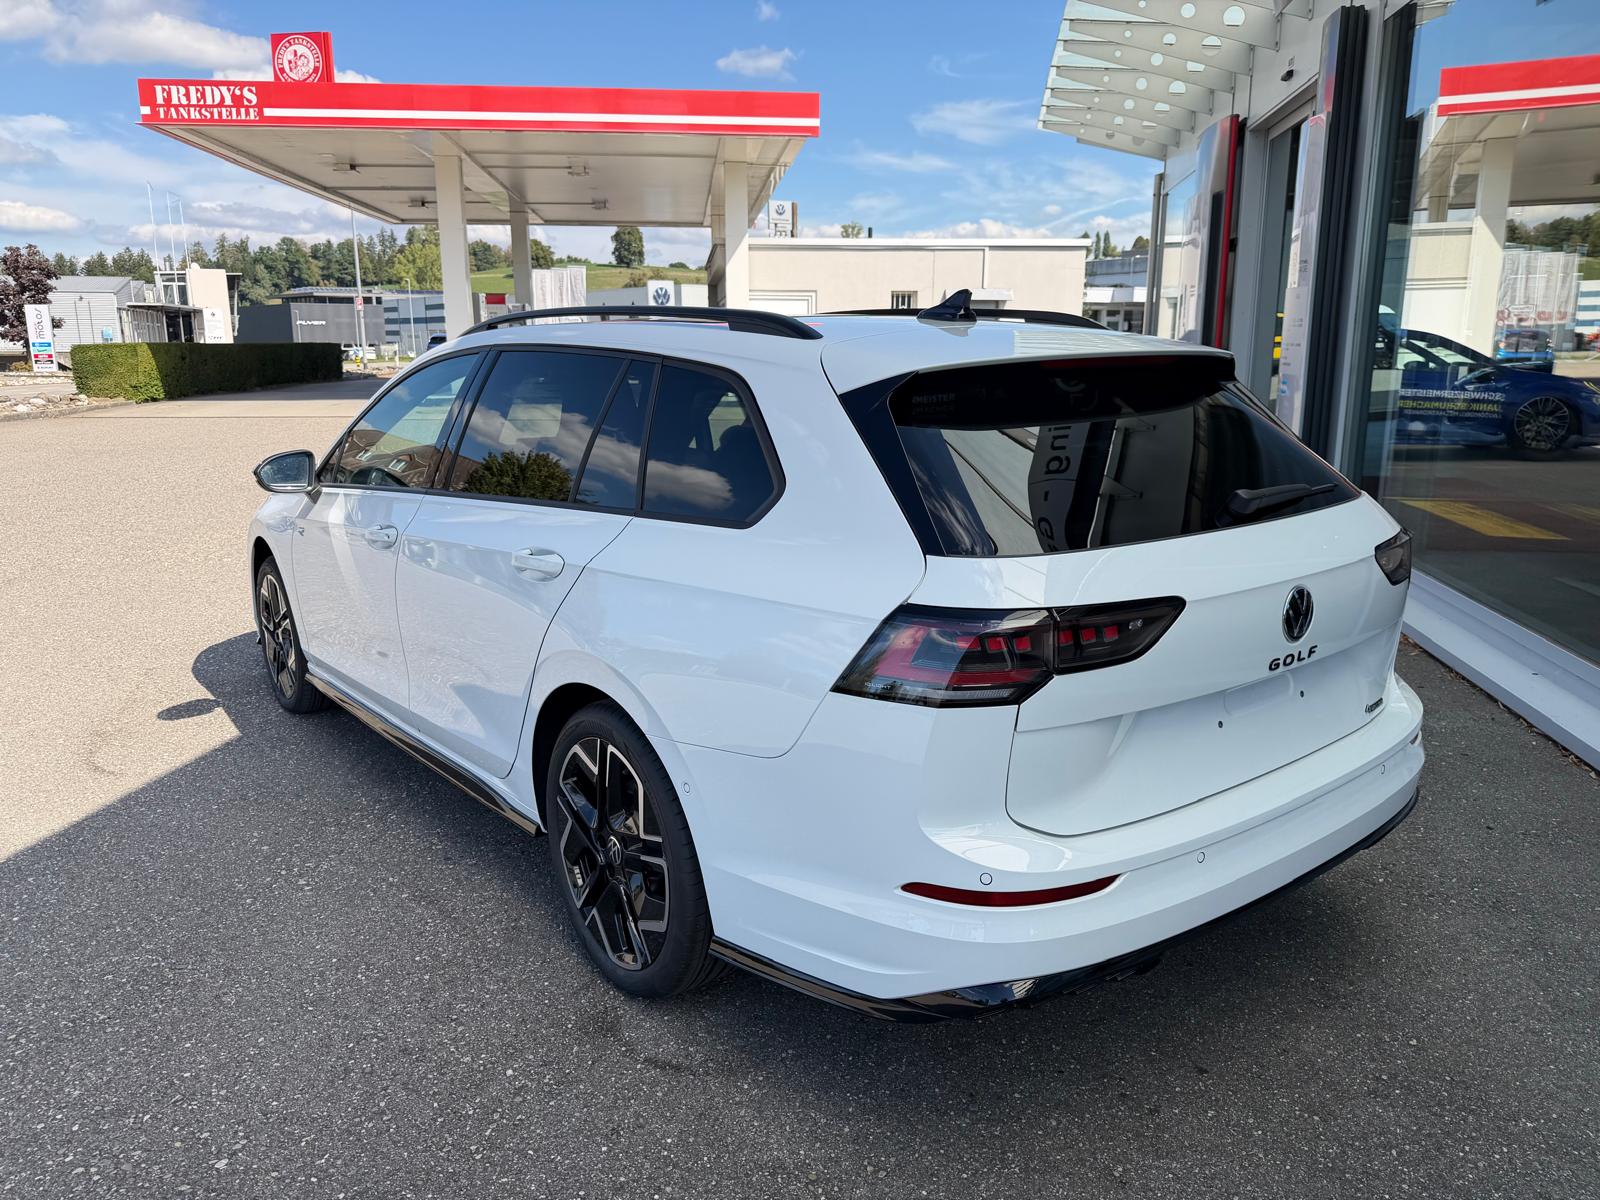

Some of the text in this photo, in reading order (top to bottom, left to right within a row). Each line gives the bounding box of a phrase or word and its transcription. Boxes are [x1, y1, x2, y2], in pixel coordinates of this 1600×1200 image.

[290, 37, 320, 67] TANKSTELLE
[154, 85, 257, 106] FREDY'S
[156, 107, 259, 120] TANKSTELLE
[1268, 644, 1318, 671] GOLF
